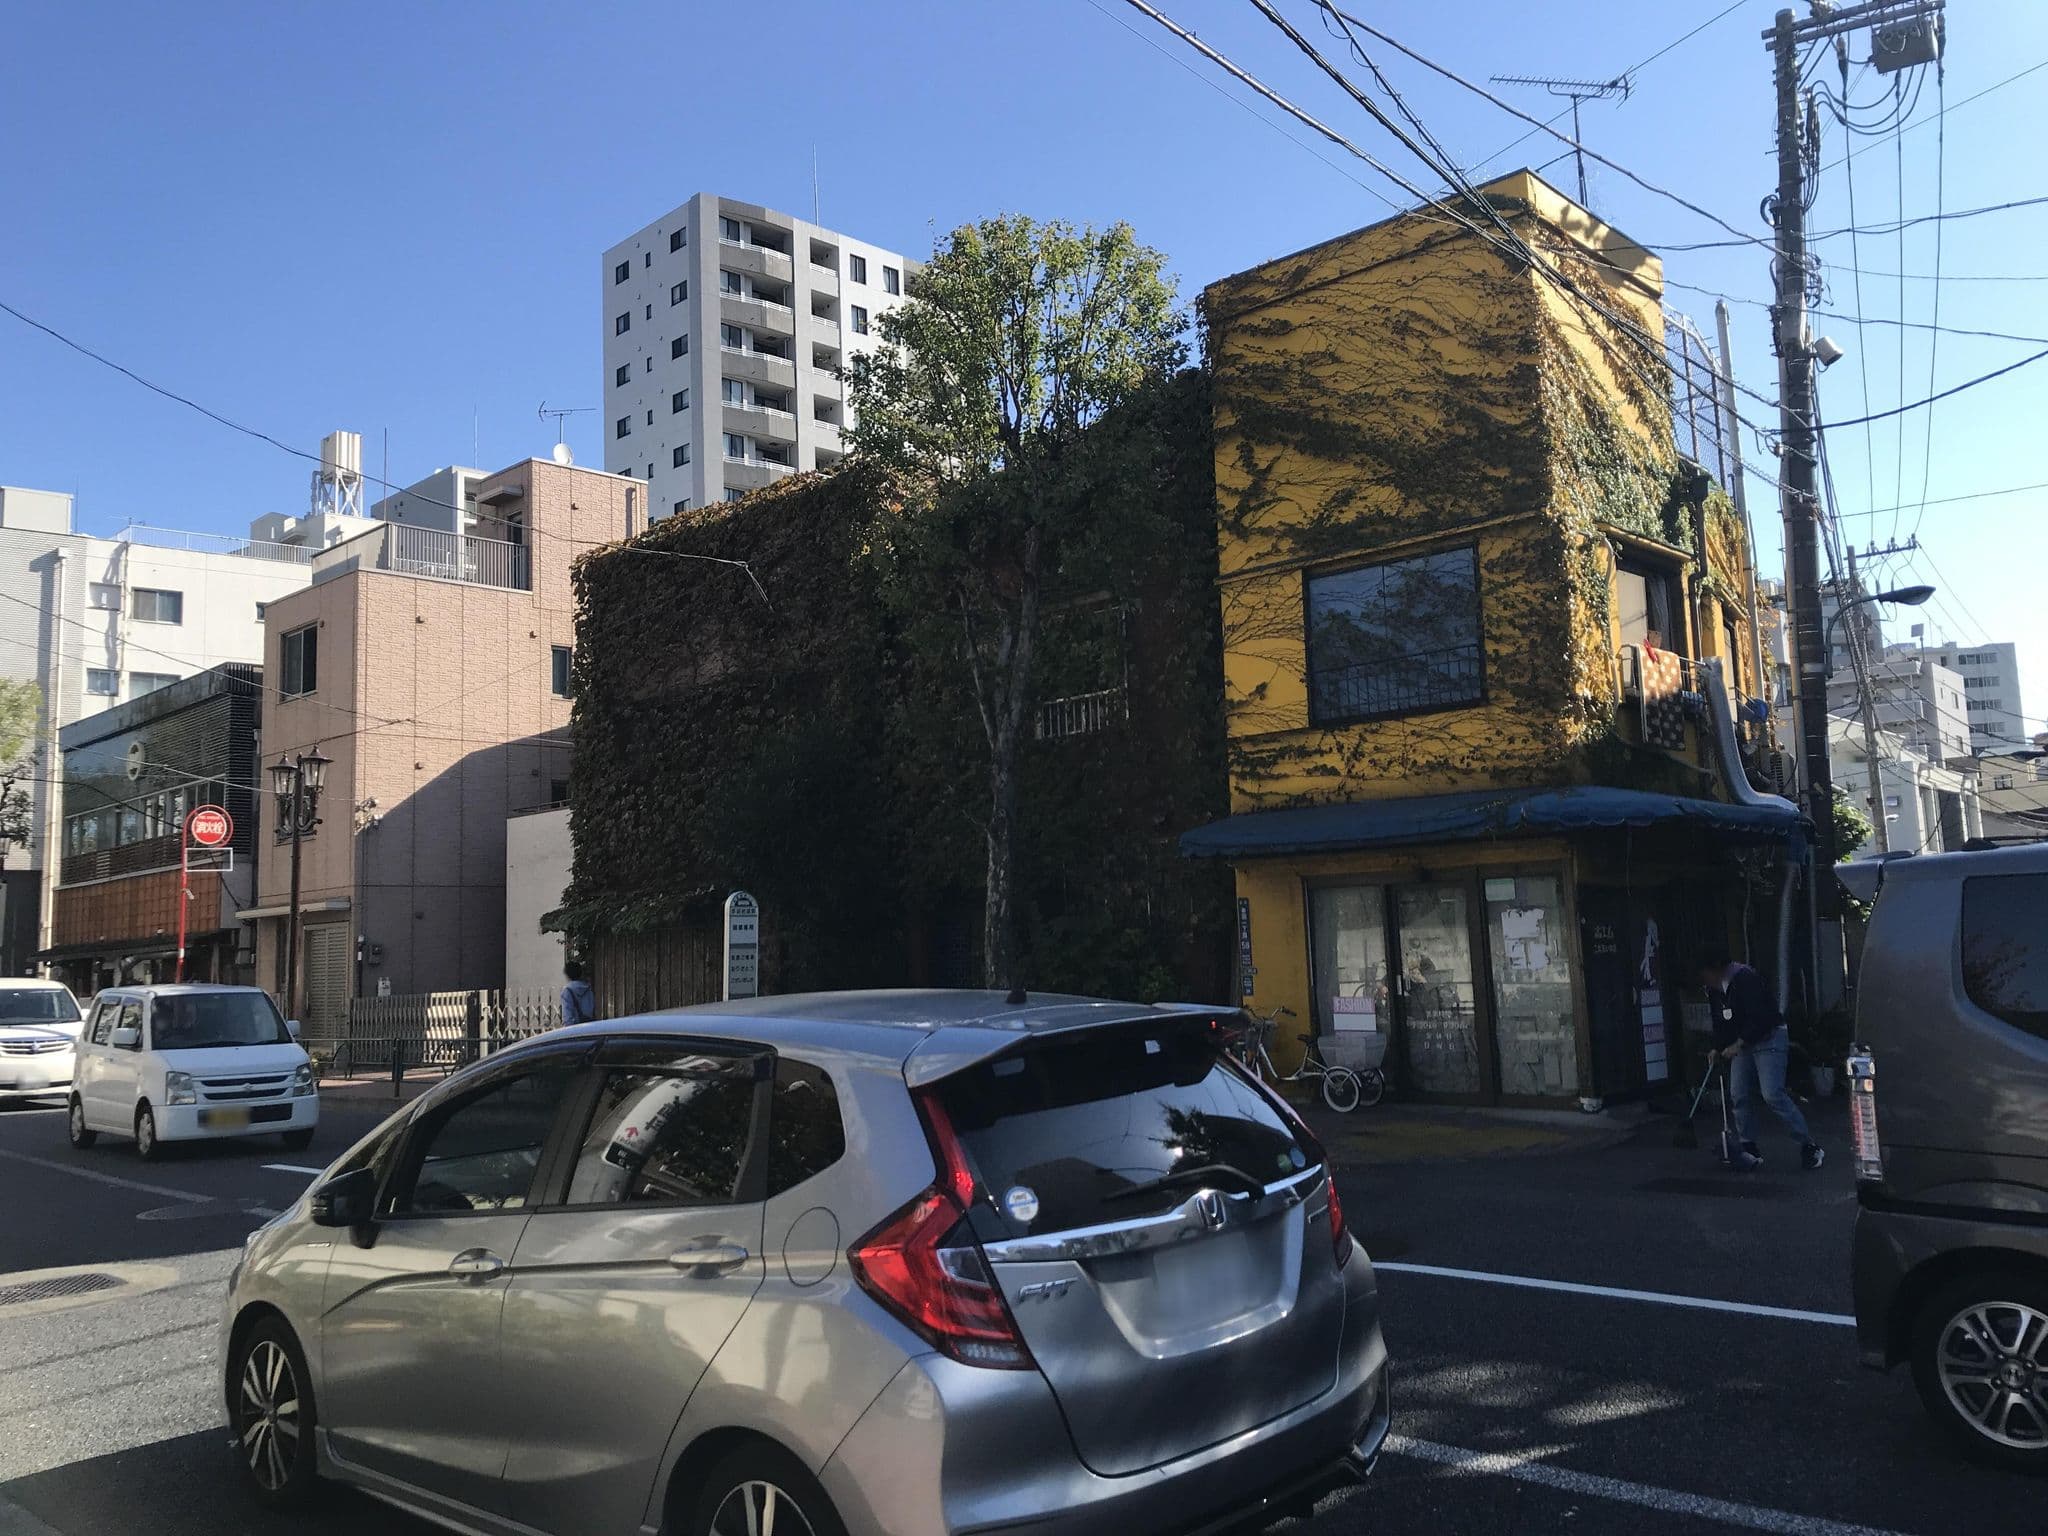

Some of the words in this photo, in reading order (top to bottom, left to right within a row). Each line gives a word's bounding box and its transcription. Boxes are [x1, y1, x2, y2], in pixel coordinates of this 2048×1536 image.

[196, 821, 224, 834] 消火栓
[1334, 998, 1373, 1012] FASHION
